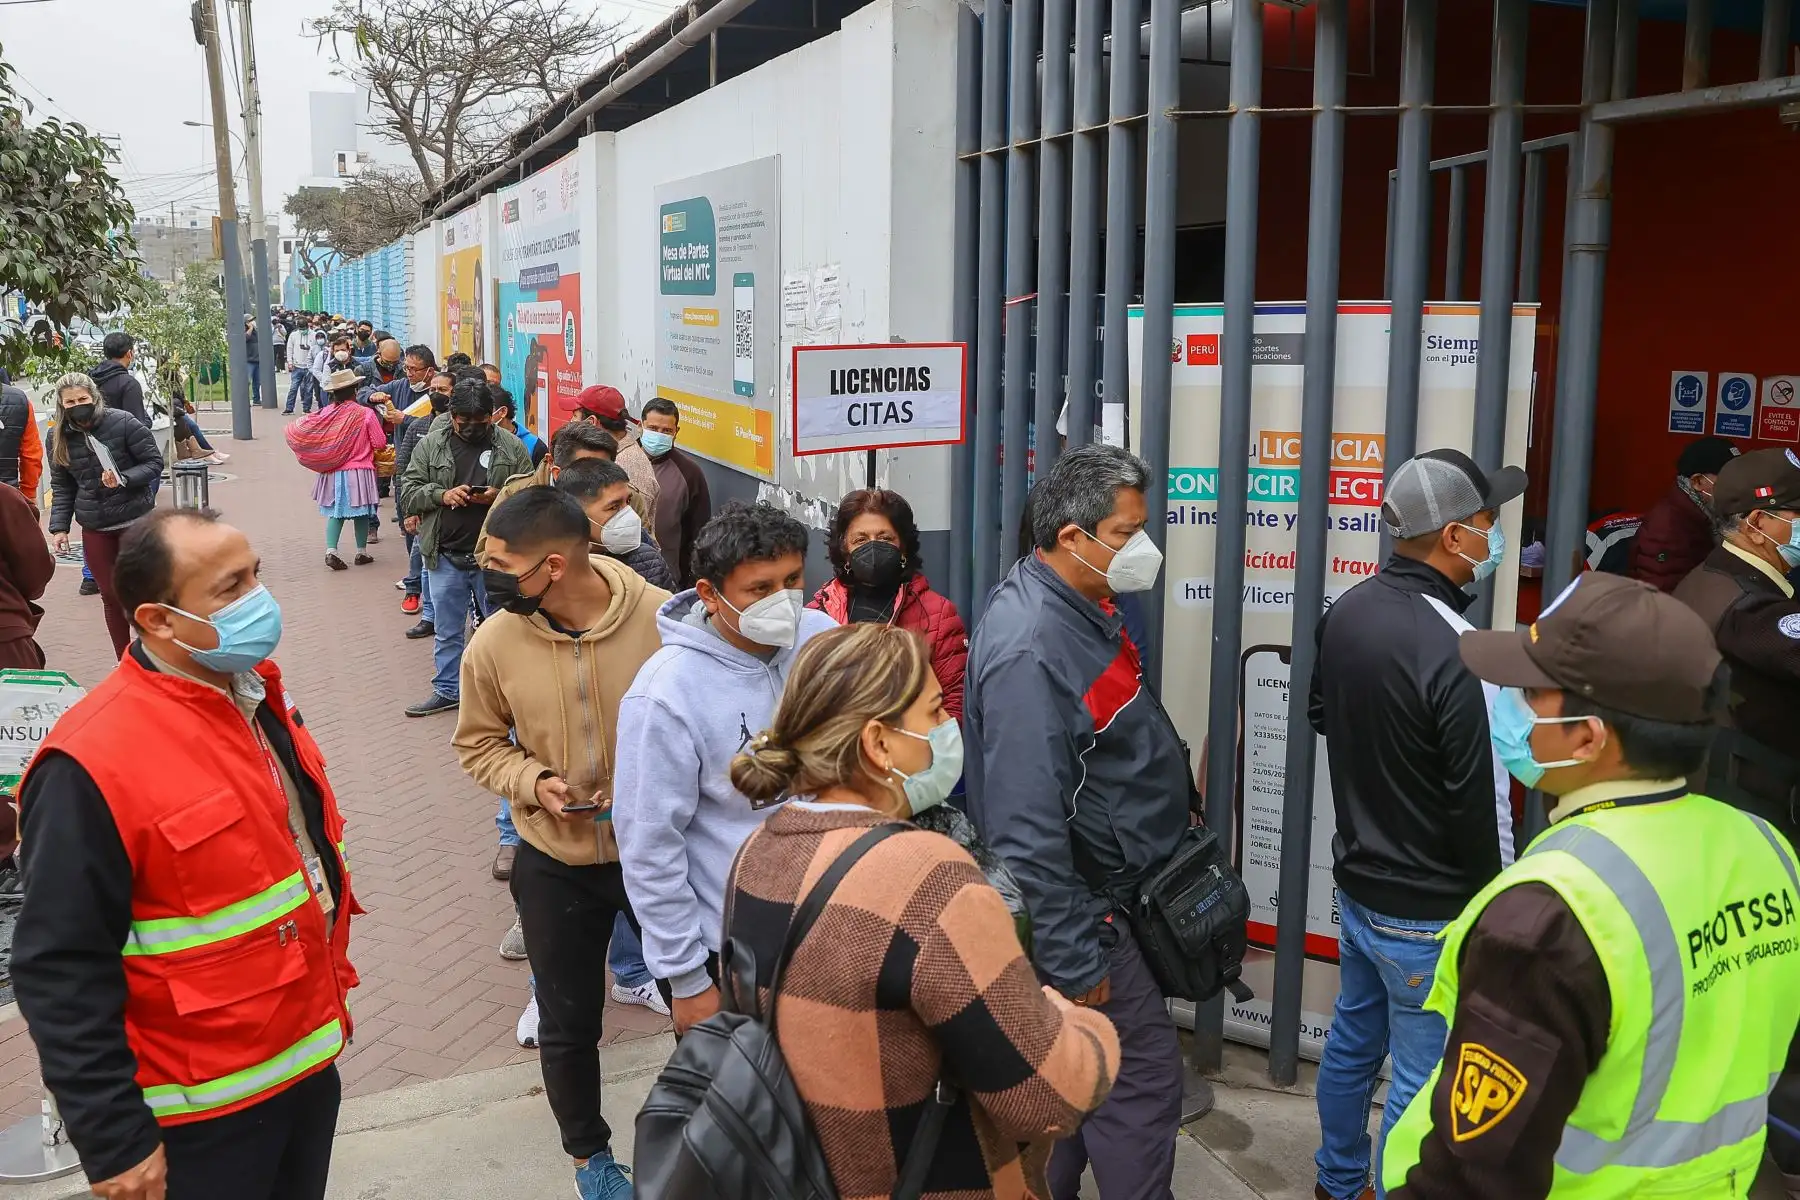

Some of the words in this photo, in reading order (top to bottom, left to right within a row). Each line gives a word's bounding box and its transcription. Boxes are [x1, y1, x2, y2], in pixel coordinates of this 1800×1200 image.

[662, 245, 677, 261] Mesa
[679, 243, 687, 260] de
[688, 242, 710, 260] Partes
[662, 264, 683, 280] Virtual
[684, 264, 694, 280] del
[695, 262, 710, 280] MTC
[1190, 344, 1215, 355] PERÚ
[1252, 345, 1279, 353] sportes
[1426, 336, 1478, 354] Siemp
[1252, 352, 1291, 360] nicaciones
[1450, 355, 1475, 366] pue
[830, 366, 931, 395] LICENCIAS
[847, 400, 914, 426] CITAS
[1764, 418, 1796, 426] CONTACTO
[1770, 424, 1789, 432] FÍSICO
[1263, 438, 1382, 462] LICCIA
[1167, 473, 1295, 496] CONCIR
[1167, 506, 1184, 524] al
[1191, 507, 1278, 528] insnte
[1285, 513, 1297, 531] y
[1338, 512, 1380, 534] sali
[1252, 768, 1285, 779] 21/05/201
[1252, 785, 1284, 796] 06/11/202
[1251, 805, 1270, 813] DATOS
[1270, 807, 1280, 815] DEL
[1251, 824, 1282, 834] HERRERA
[1250, 841, 1272, 850] JORGE
[1687, 888, 1796, 969] PROTSSA
[1732, 953, 1742, 970] Y
[1456, 1064, 1509, 1124] SP
